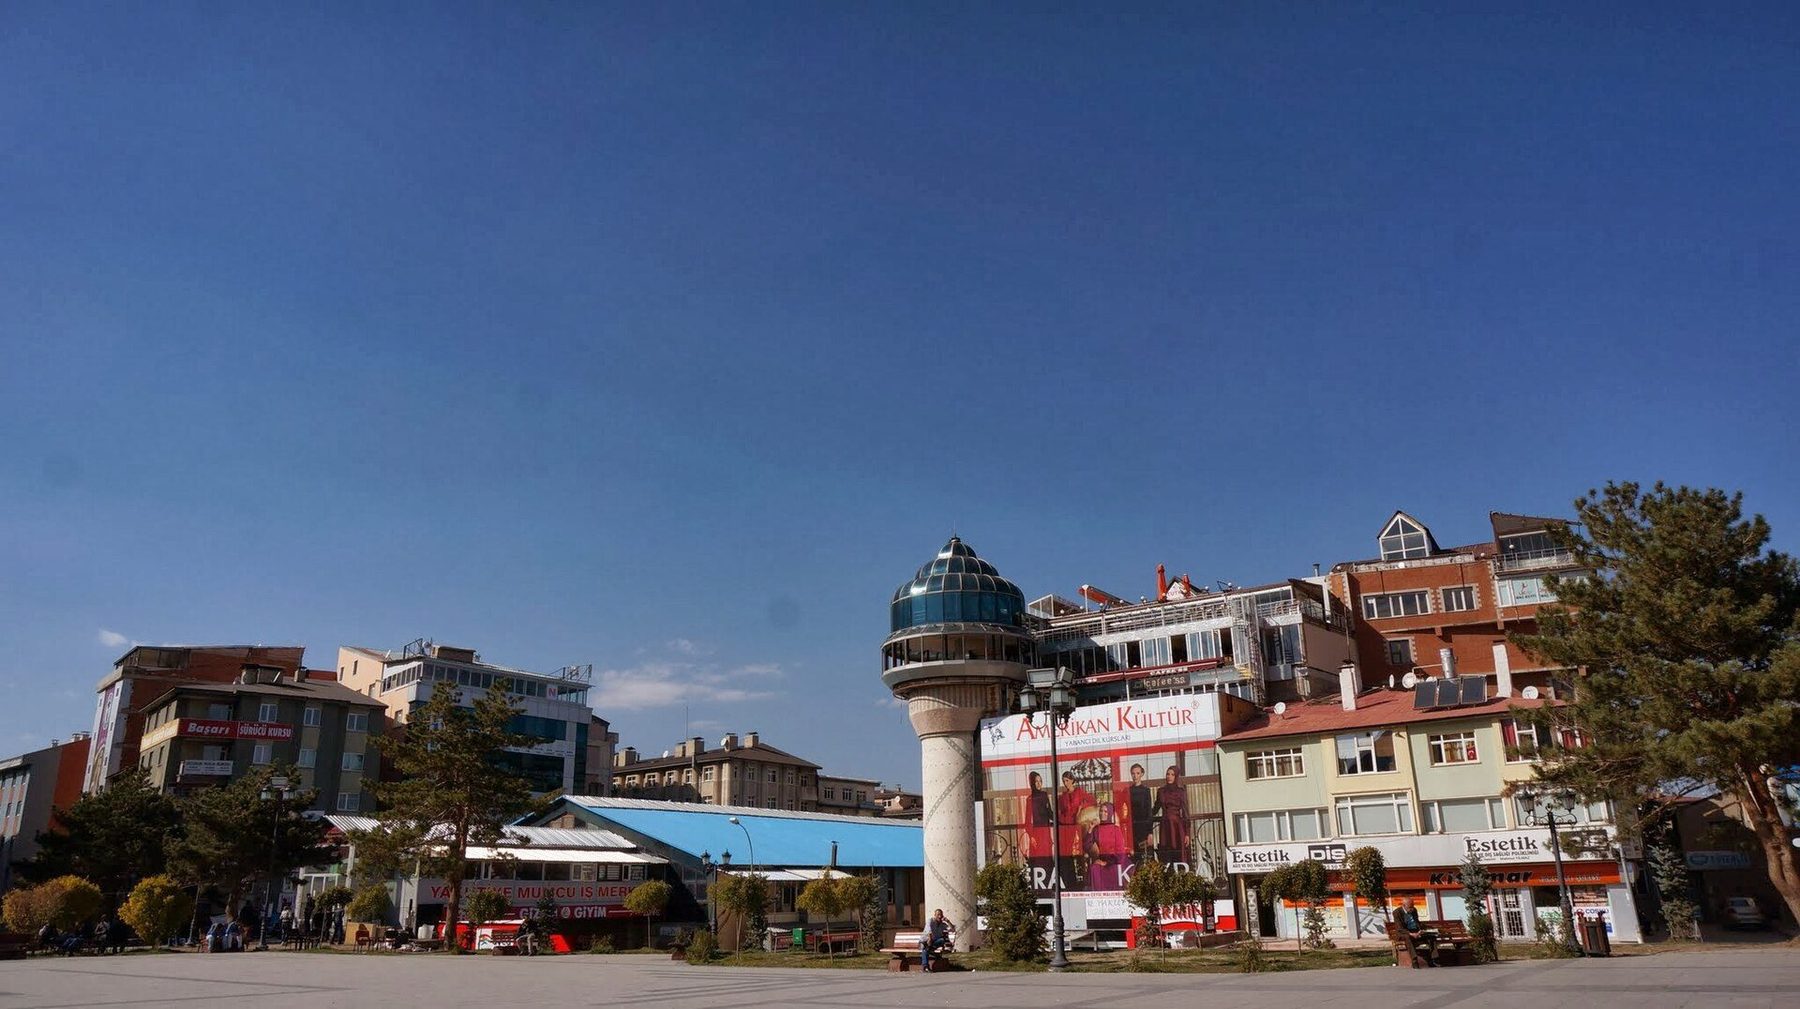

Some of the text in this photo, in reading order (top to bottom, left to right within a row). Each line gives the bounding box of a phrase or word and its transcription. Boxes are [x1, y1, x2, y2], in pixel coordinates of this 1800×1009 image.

[187, 722, 291, 738] Başarı SÜRÜCÜ KURSU
[1017, 706, 1194, 741] AMRİKAN KÜLTÜR
[1464, 836, 1538, 852] Estetik
[1232, 849, 1290, 863] Estetik
[574, 906, 607, 918] GİYİM
